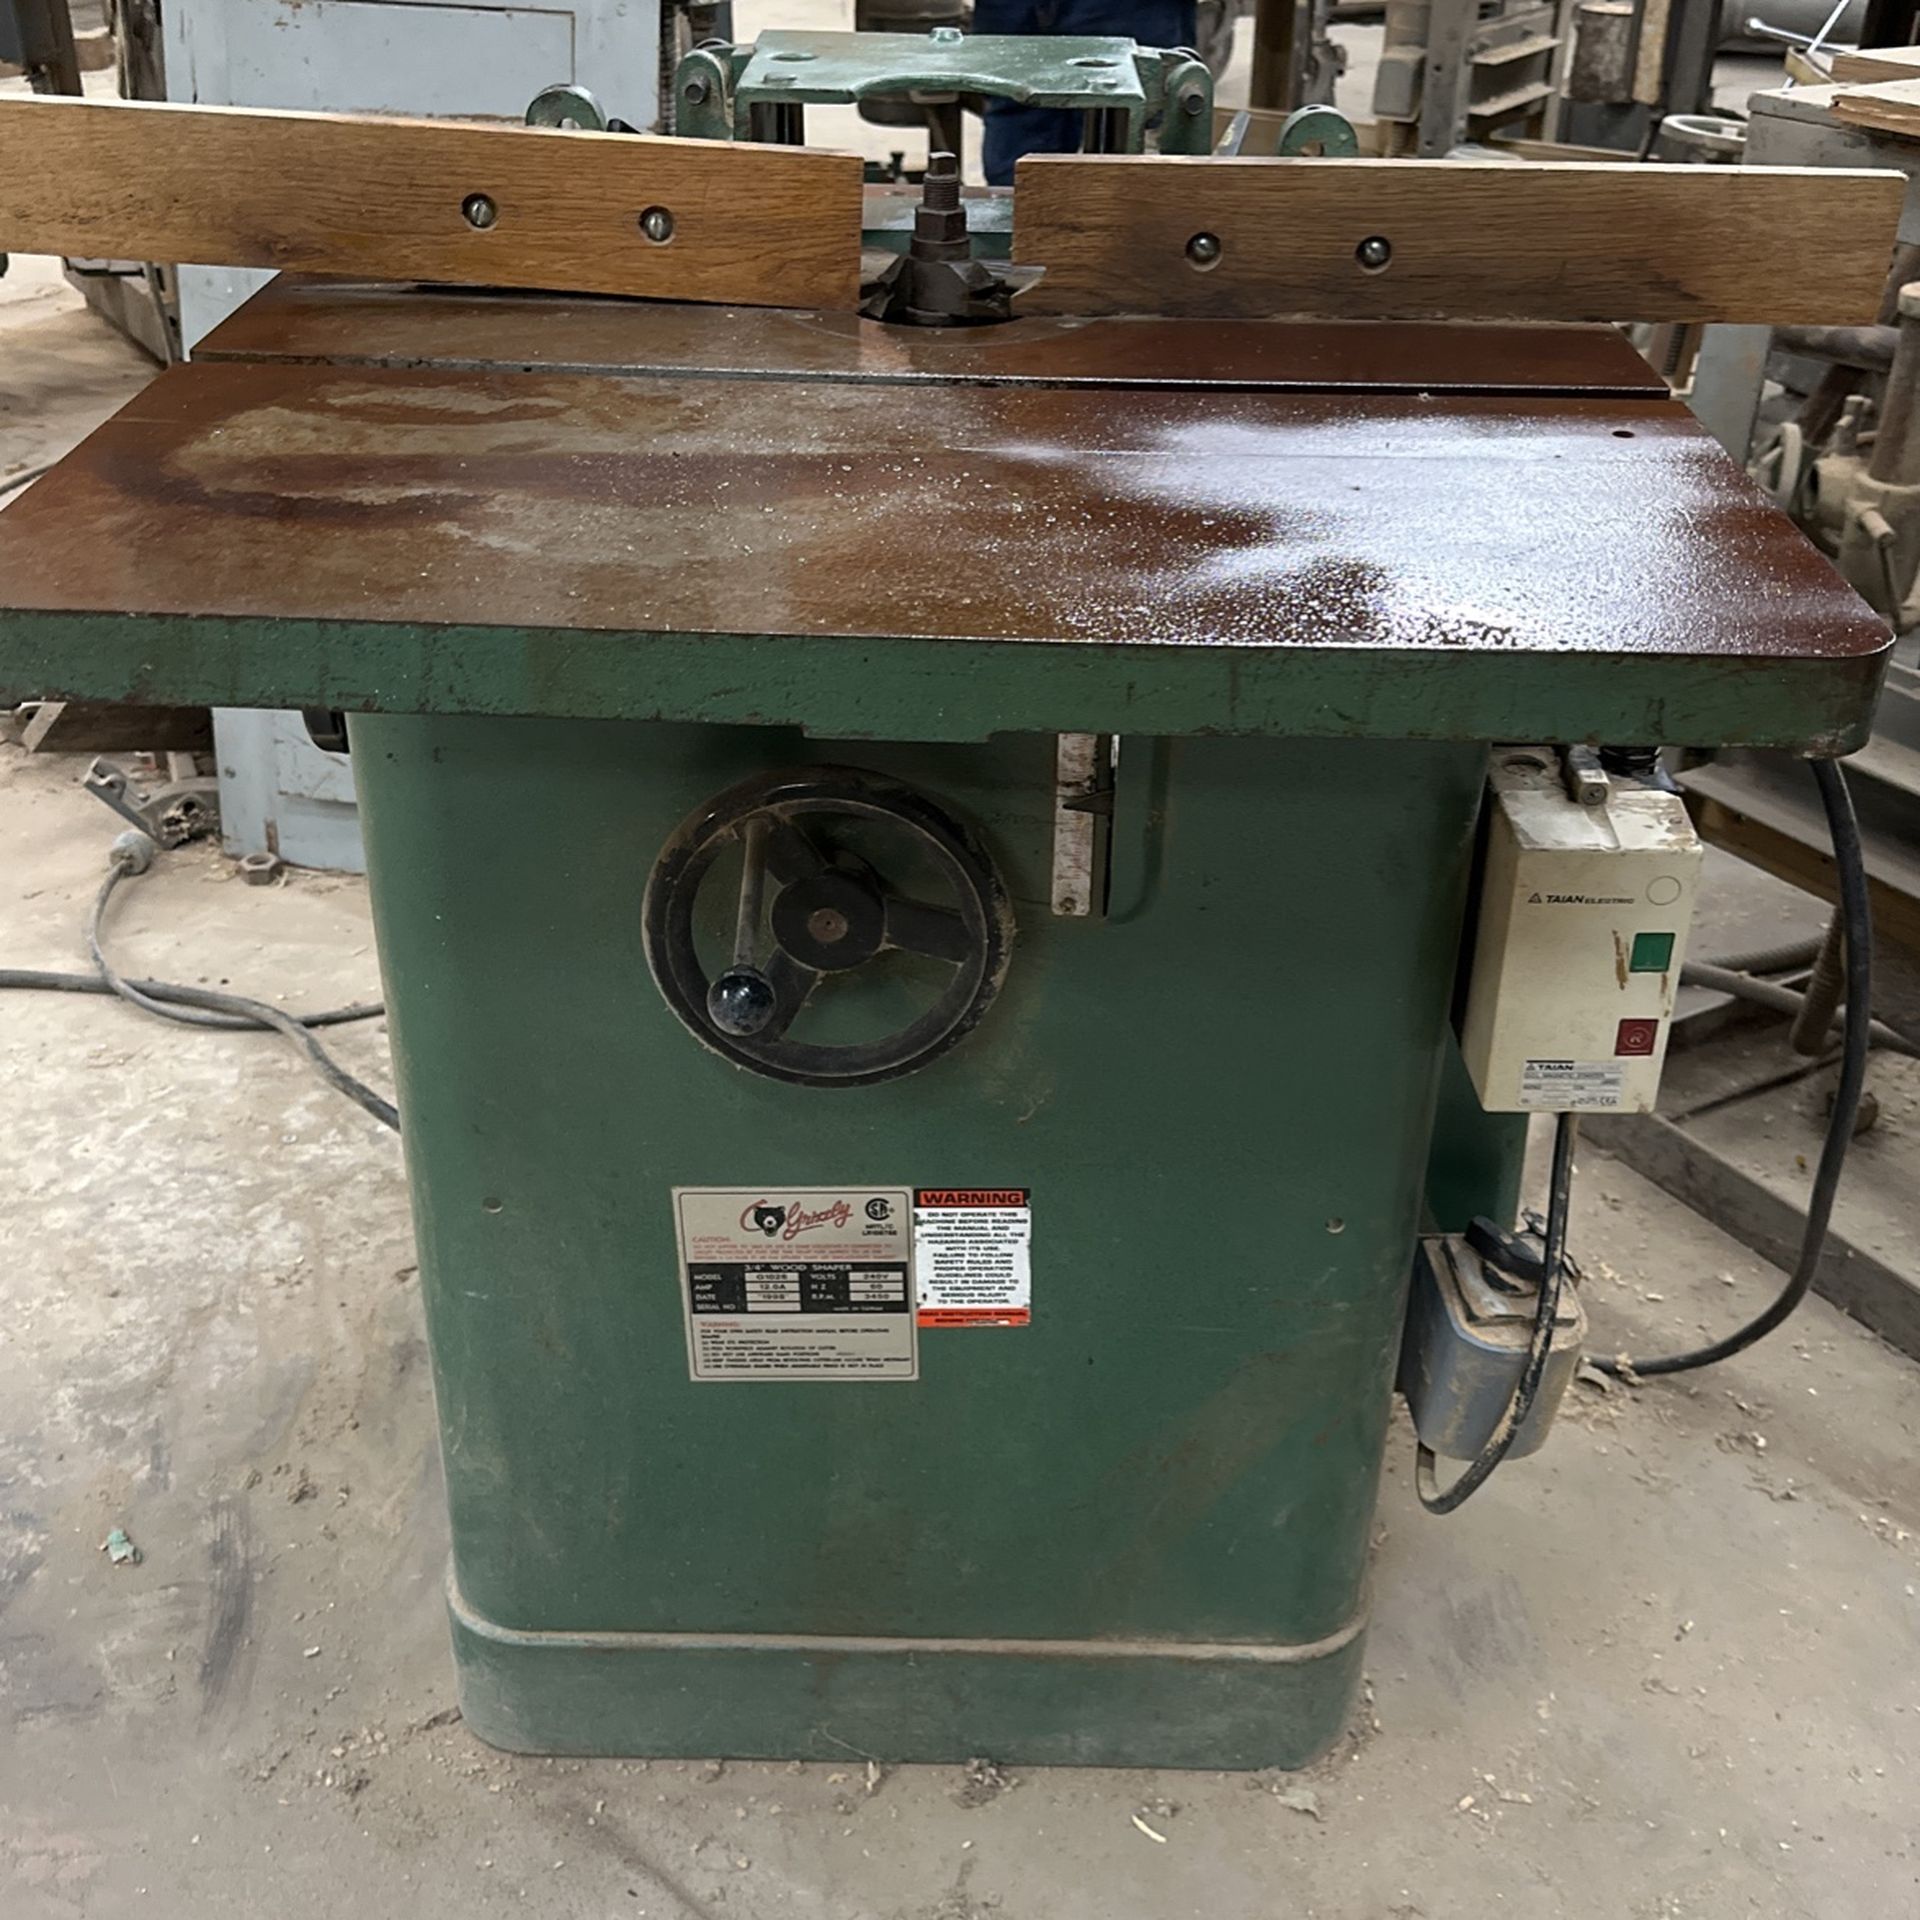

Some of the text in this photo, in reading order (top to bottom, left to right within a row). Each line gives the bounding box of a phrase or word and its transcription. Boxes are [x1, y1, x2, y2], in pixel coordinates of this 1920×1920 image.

[1546, 895, 1584, 904] TAIAN
[923, 1192, 1021, 1204] WARNING
[783, 1200, 854, 1240] Grizzly
[695, 1293, 717, 1301] DATE
[696, 1303, 720, 1311] SERIAL
